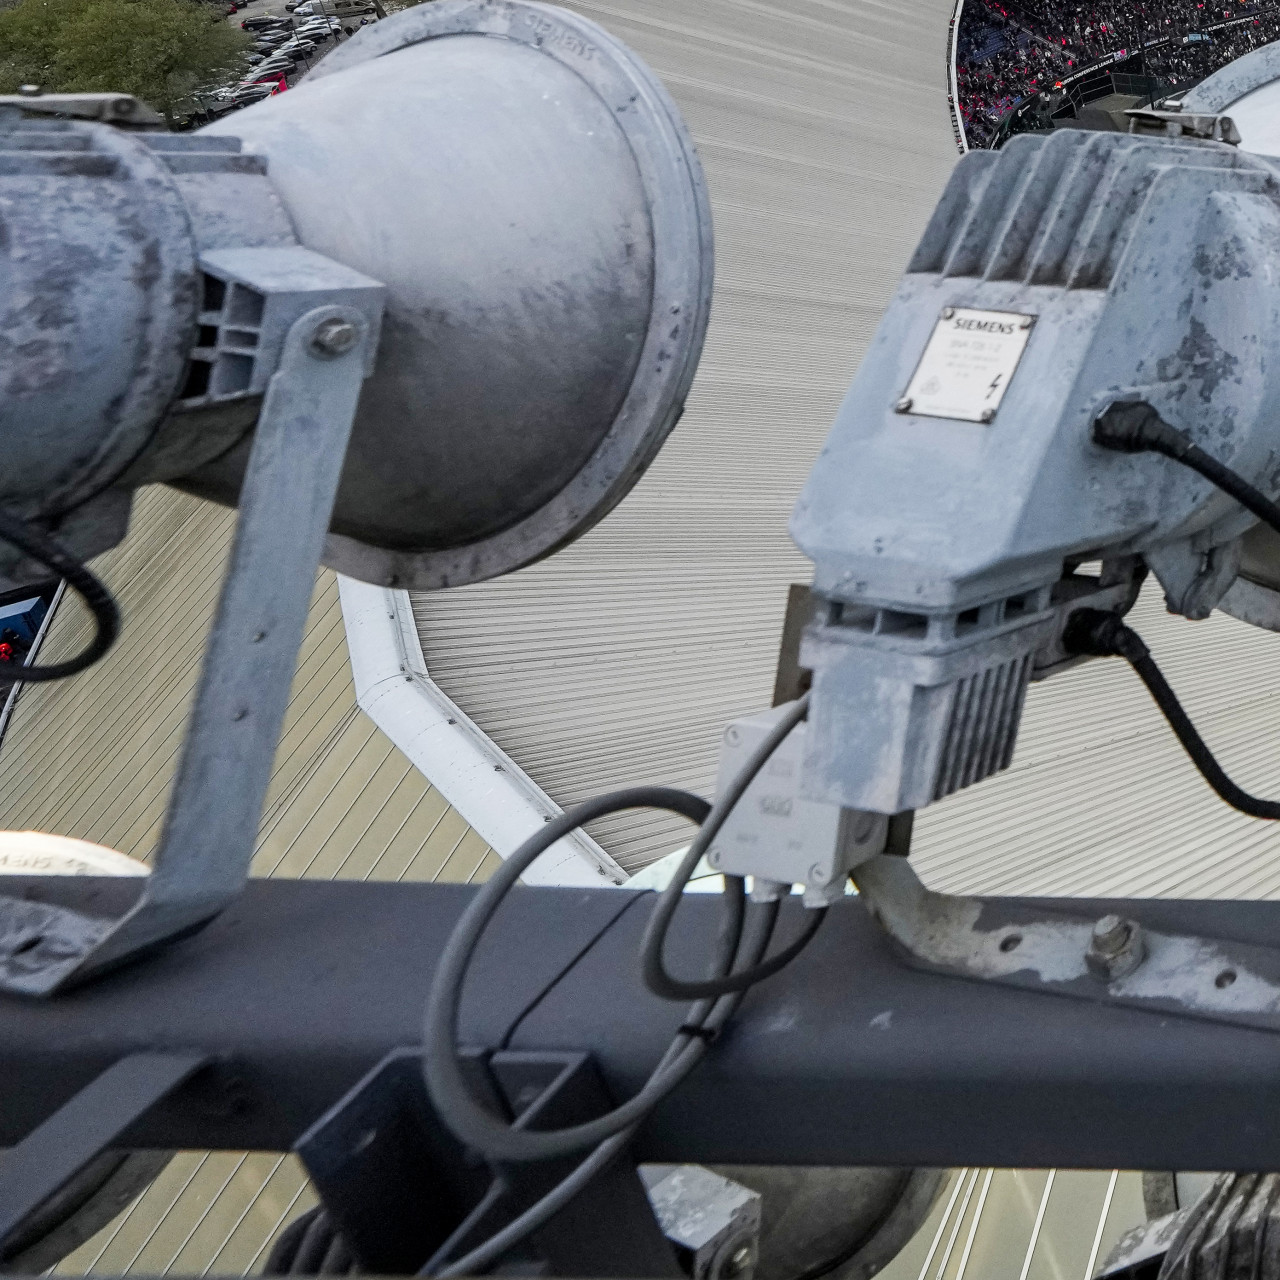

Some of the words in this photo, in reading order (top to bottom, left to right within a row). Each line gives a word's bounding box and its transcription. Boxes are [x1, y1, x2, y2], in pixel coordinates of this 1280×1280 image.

[1074, 64, 1099, 79] CONFERENCE
[1099, 58, 1113, 68] LEAGUE
[953, 317, 1016, 334] SIEMENS
